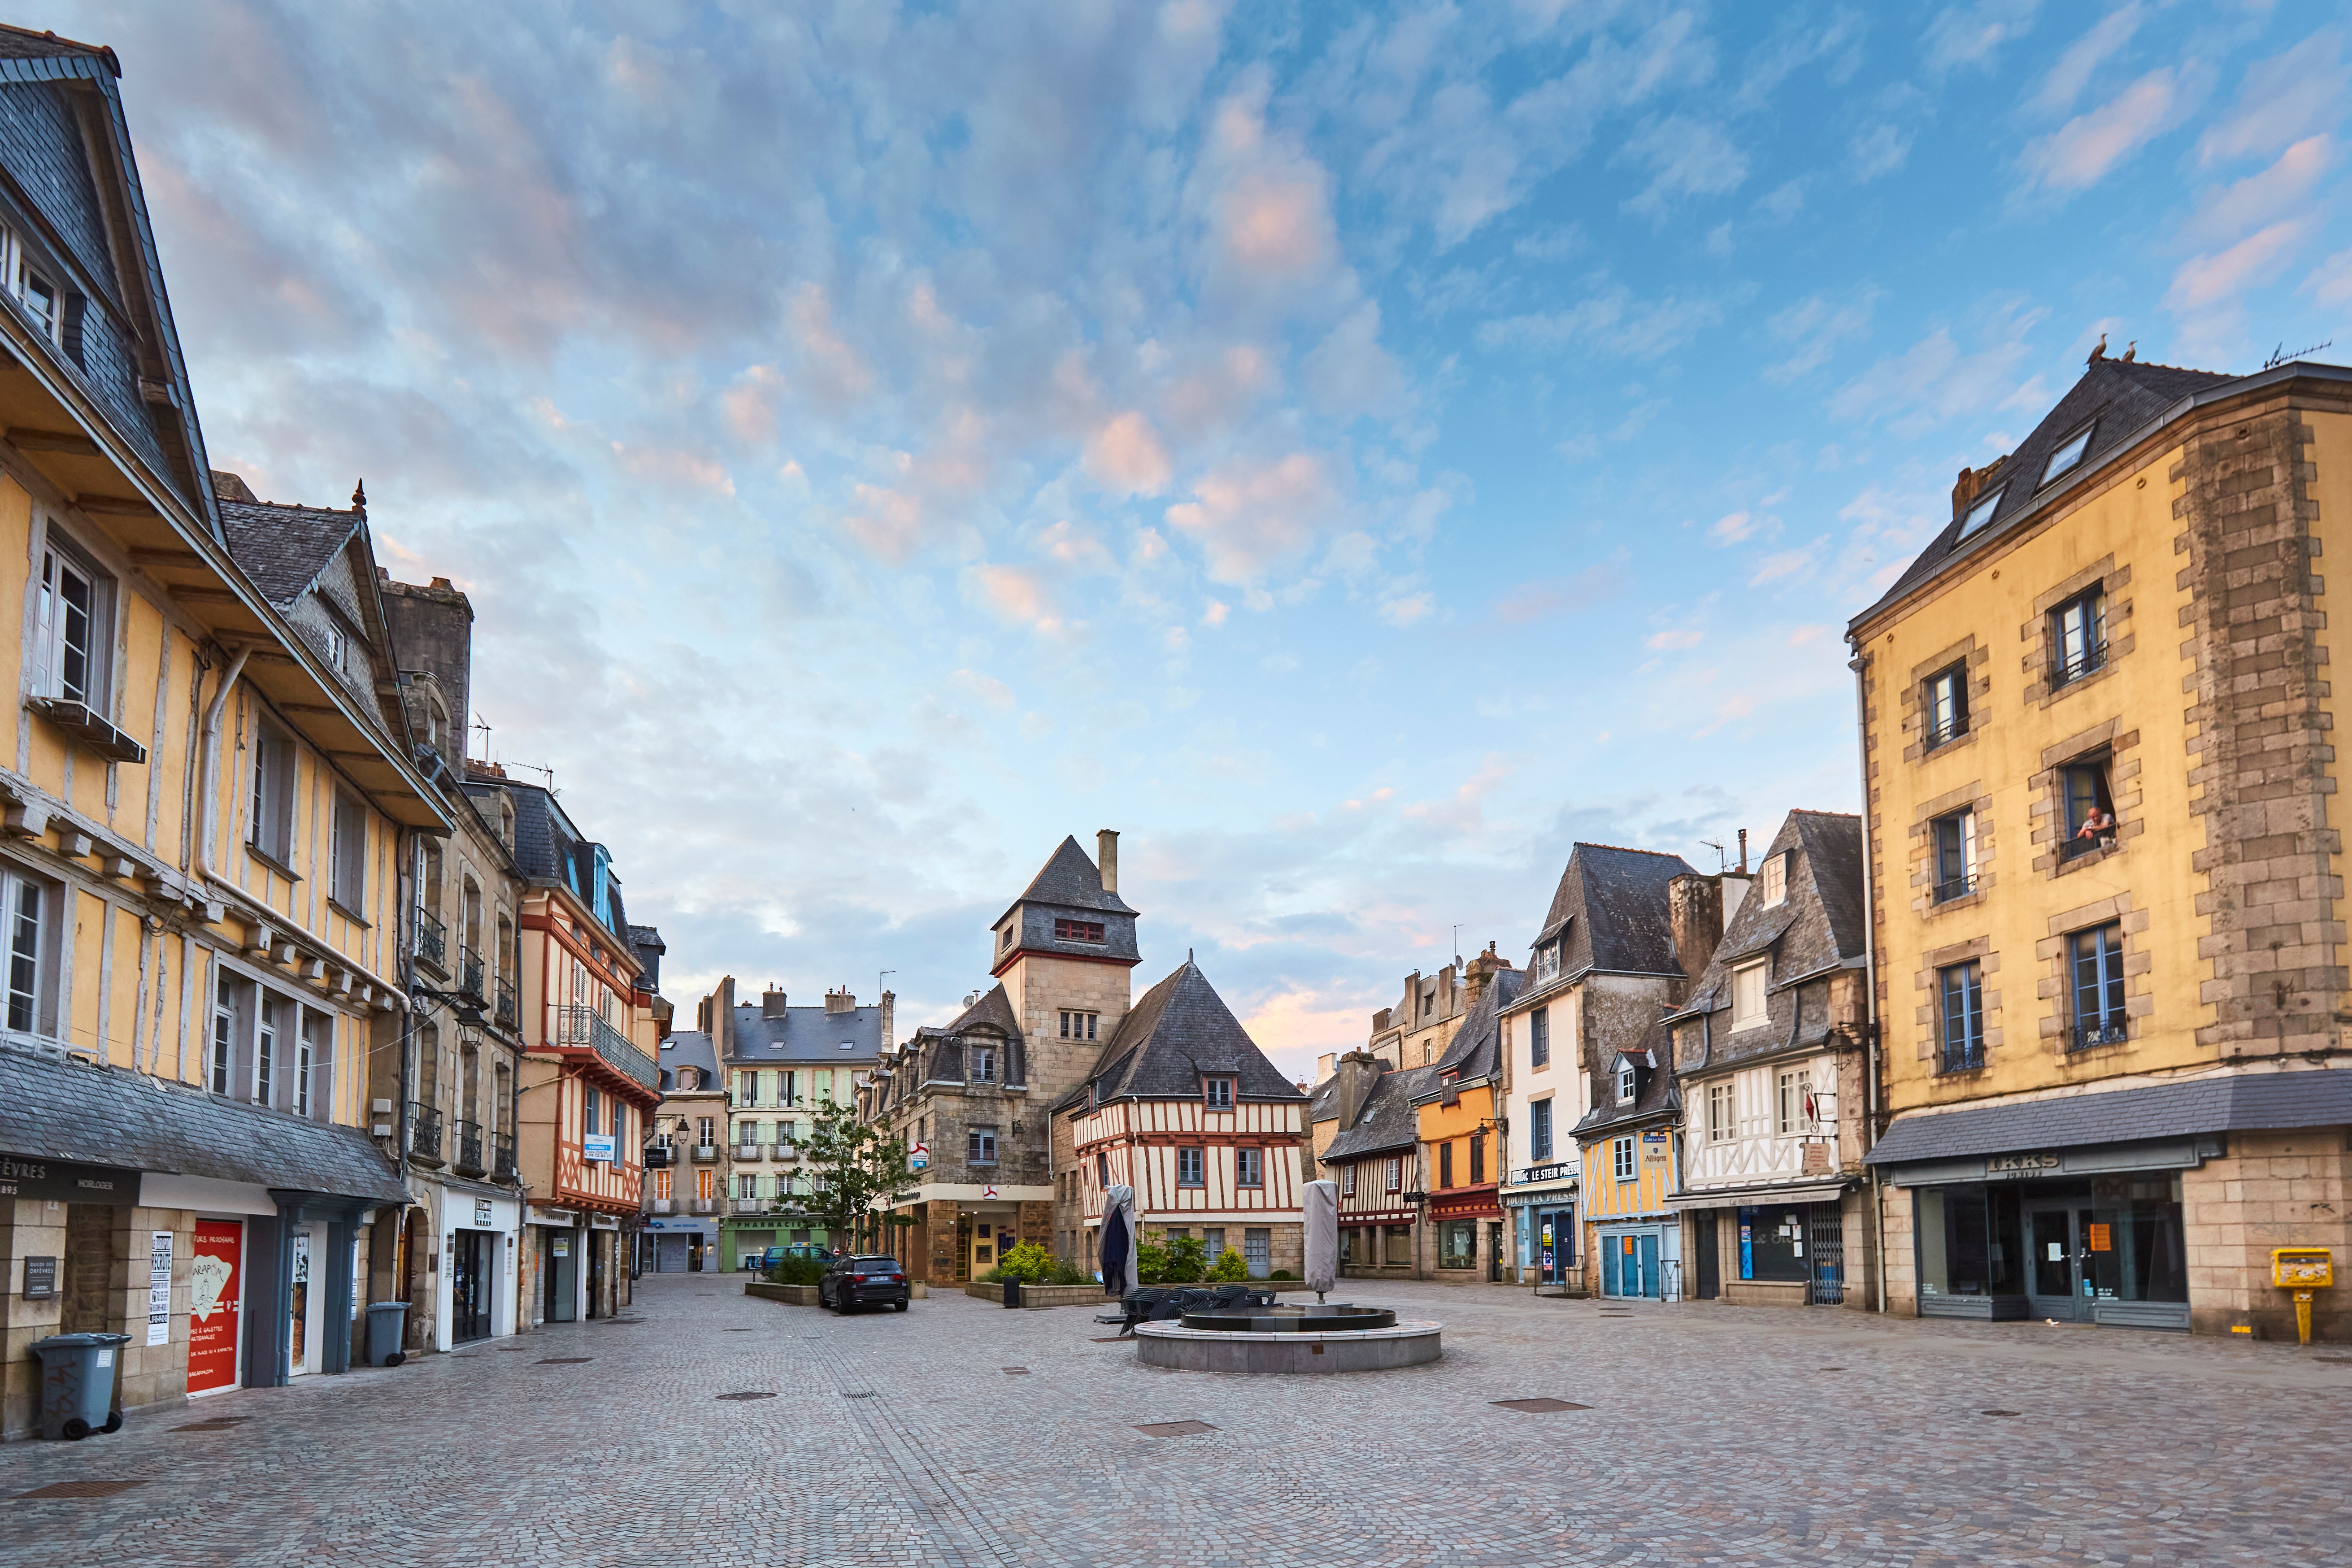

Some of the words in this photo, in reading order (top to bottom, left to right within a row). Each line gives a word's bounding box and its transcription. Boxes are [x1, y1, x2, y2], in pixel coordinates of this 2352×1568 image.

[0, 1158, 45, 1178] ÈVRES
[1988, 1153, 2060, 1172] IKKS
[1513, 1172, 1528, 1183] TABAC
[1532, 1170, 1539, 1181] LE
[1541, 1167, 1558, 1180] STEIR
[1560, 1164, 1580, 1177] PRESSE
[2005, 1171, 2043, 1179] JUNIOR
[0, 1185, 17, 1194] 895
[78, 1179, 113, 1190] HORLOGER
[1506, 1196, 1530, 1206] TOUTE
[1533, 1194, 1543, 1203] LA
[1547, 1190, 1579, 1202] PRESSE
[477, 1211, 491, 1220] BRETONNE
[152, 1253, 170, 1270] RECRUTE
